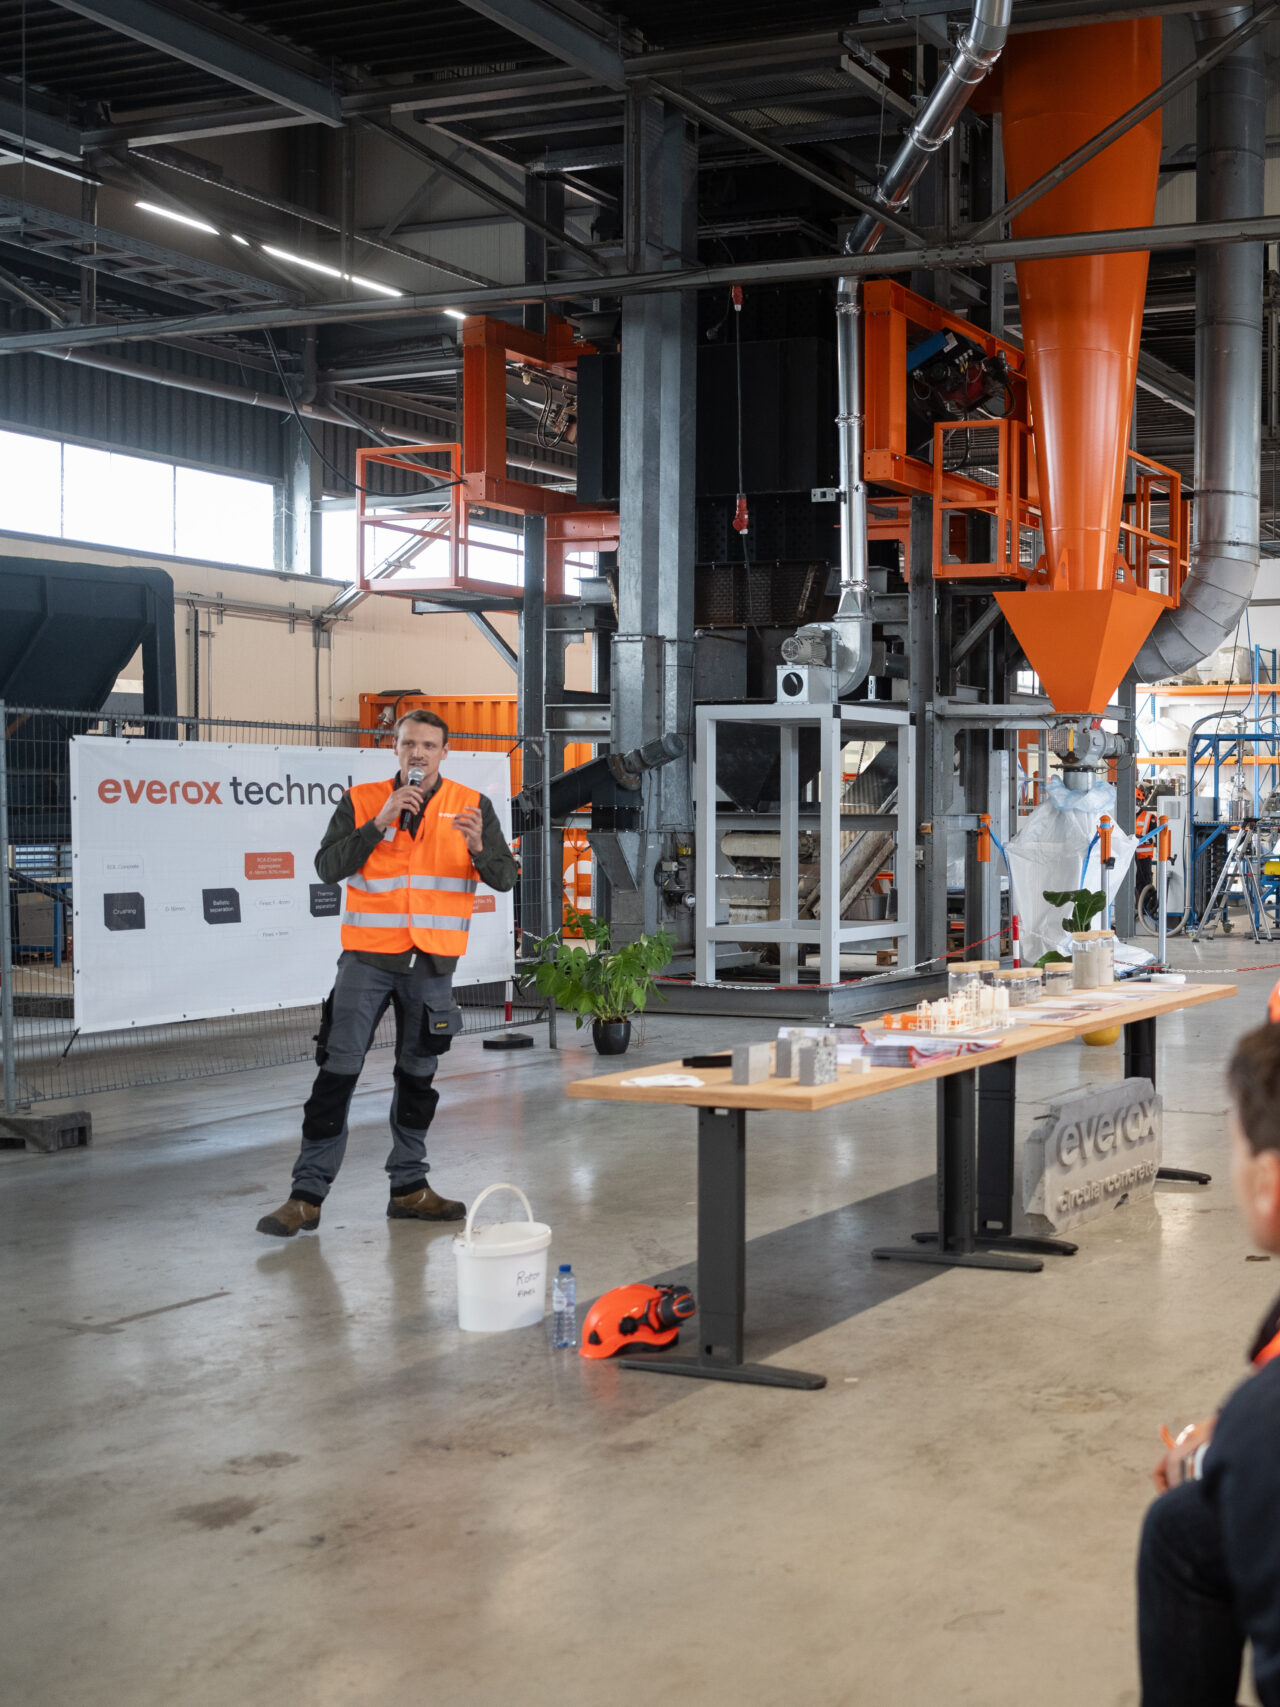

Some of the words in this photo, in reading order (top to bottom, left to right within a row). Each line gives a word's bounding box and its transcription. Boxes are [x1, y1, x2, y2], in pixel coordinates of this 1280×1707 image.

[98, 778, 223, 805] everox
[1057, 1101, 1158, 1168] everox
[1058, 1180, 1105, 1212] circular
